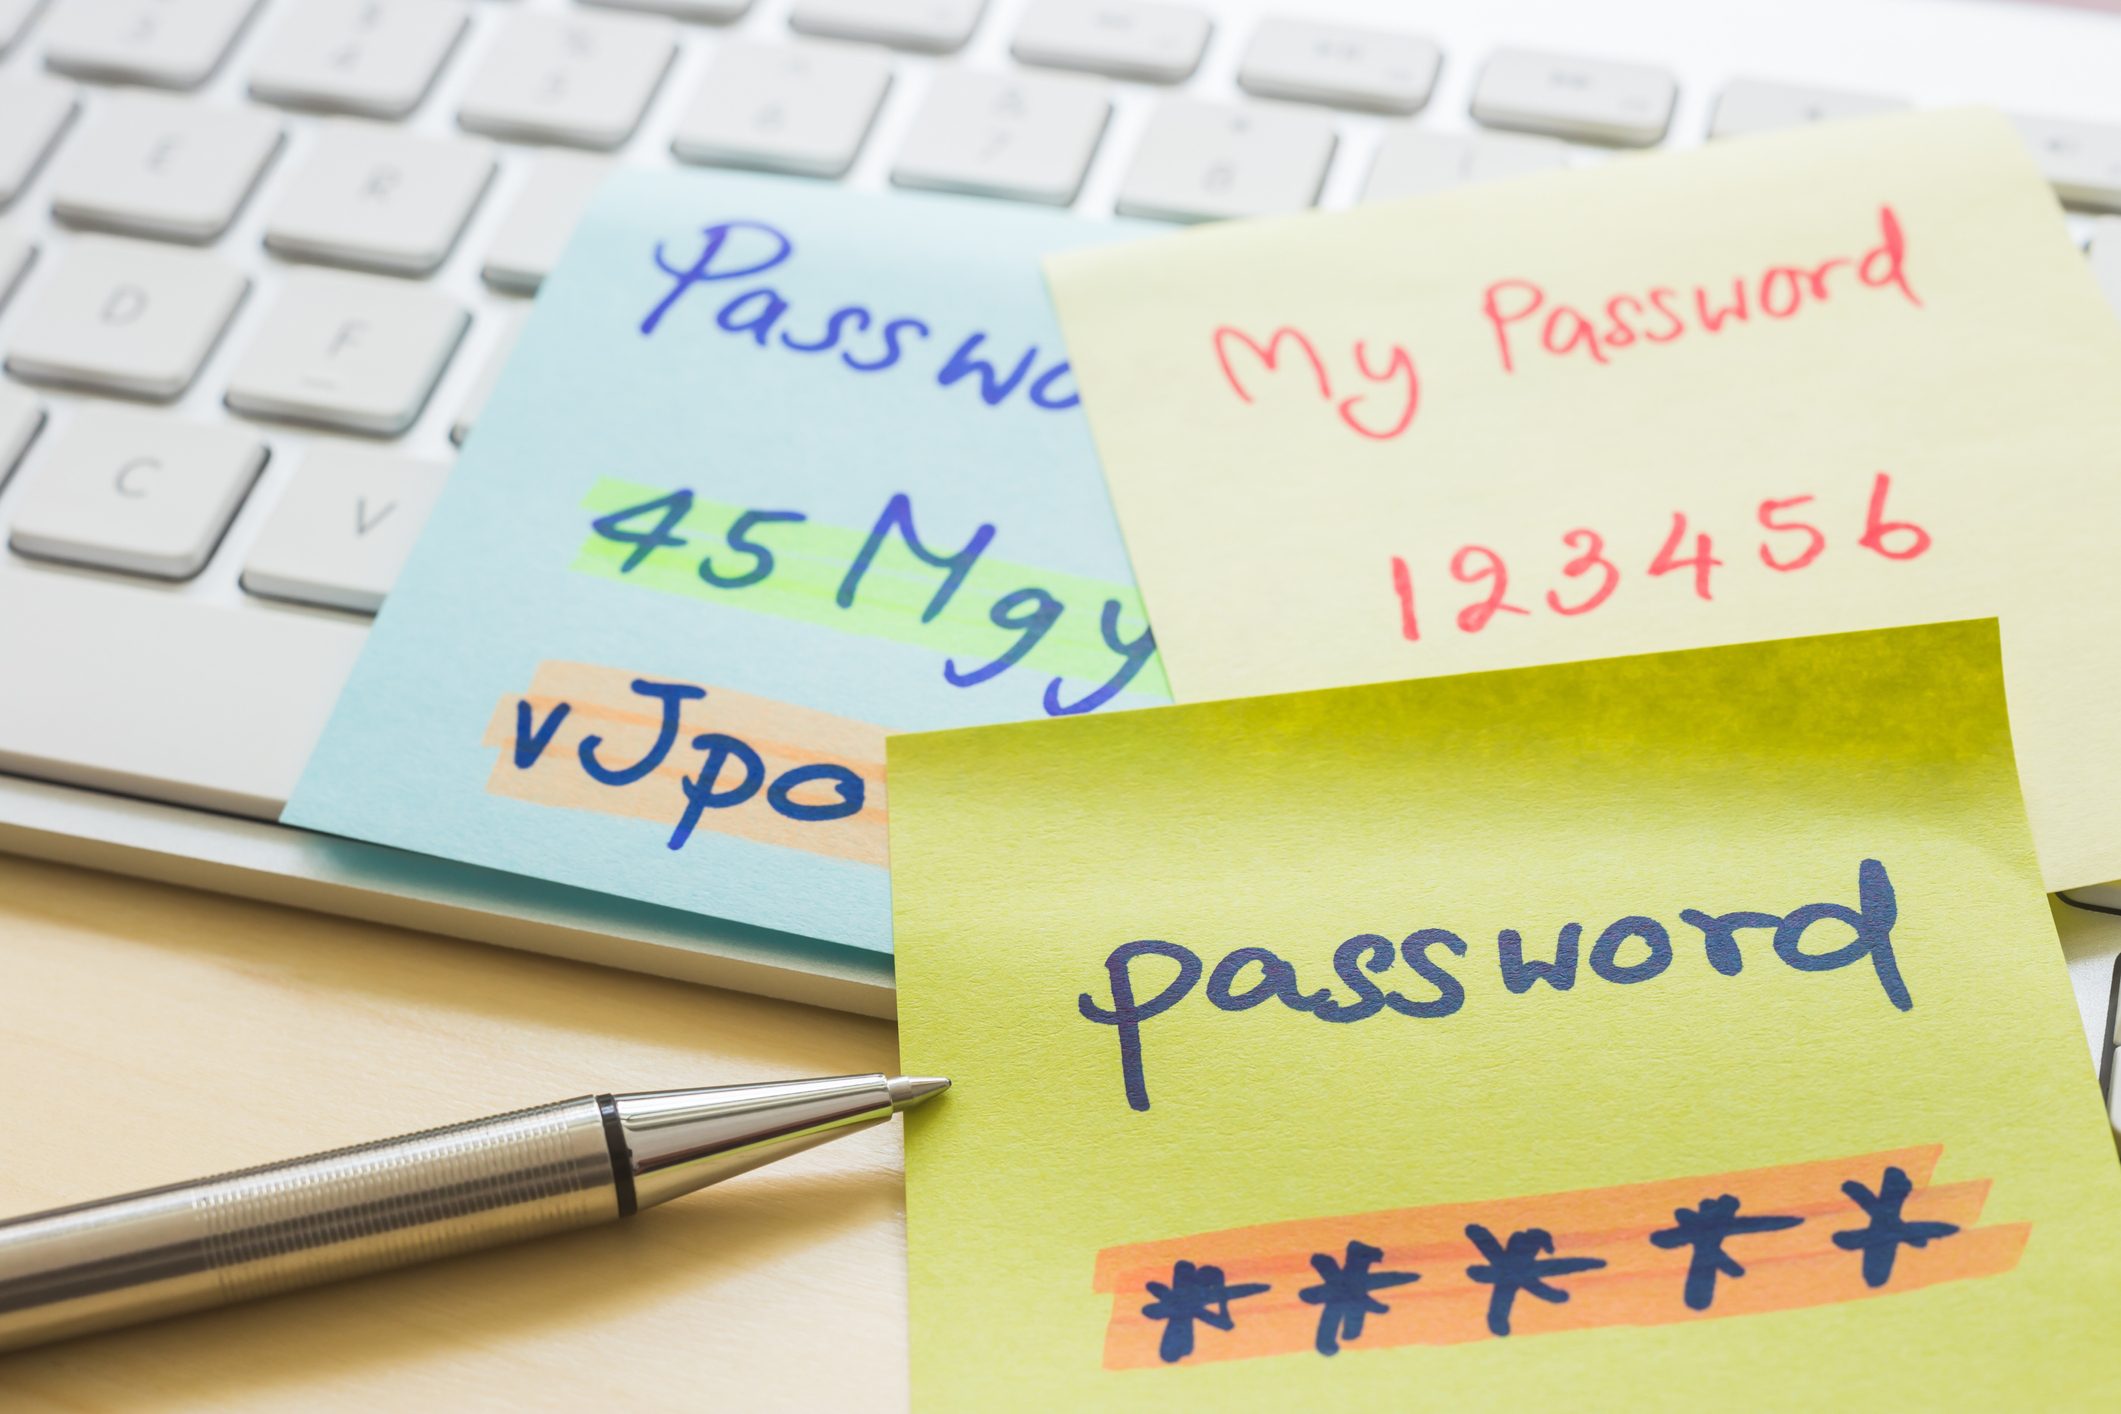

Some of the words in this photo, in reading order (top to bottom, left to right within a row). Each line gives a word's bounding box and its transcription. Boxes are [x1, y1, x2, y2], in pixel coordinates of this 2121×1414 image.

[99, 283, 150, 326] D
[1212, 324, 1422, 441] My
[1482, 204, 1922, 375] Password
[115, 455, 164, 499] C
[354, 496, 398, 535] V
[1077, 857, 1914, 1113] password
